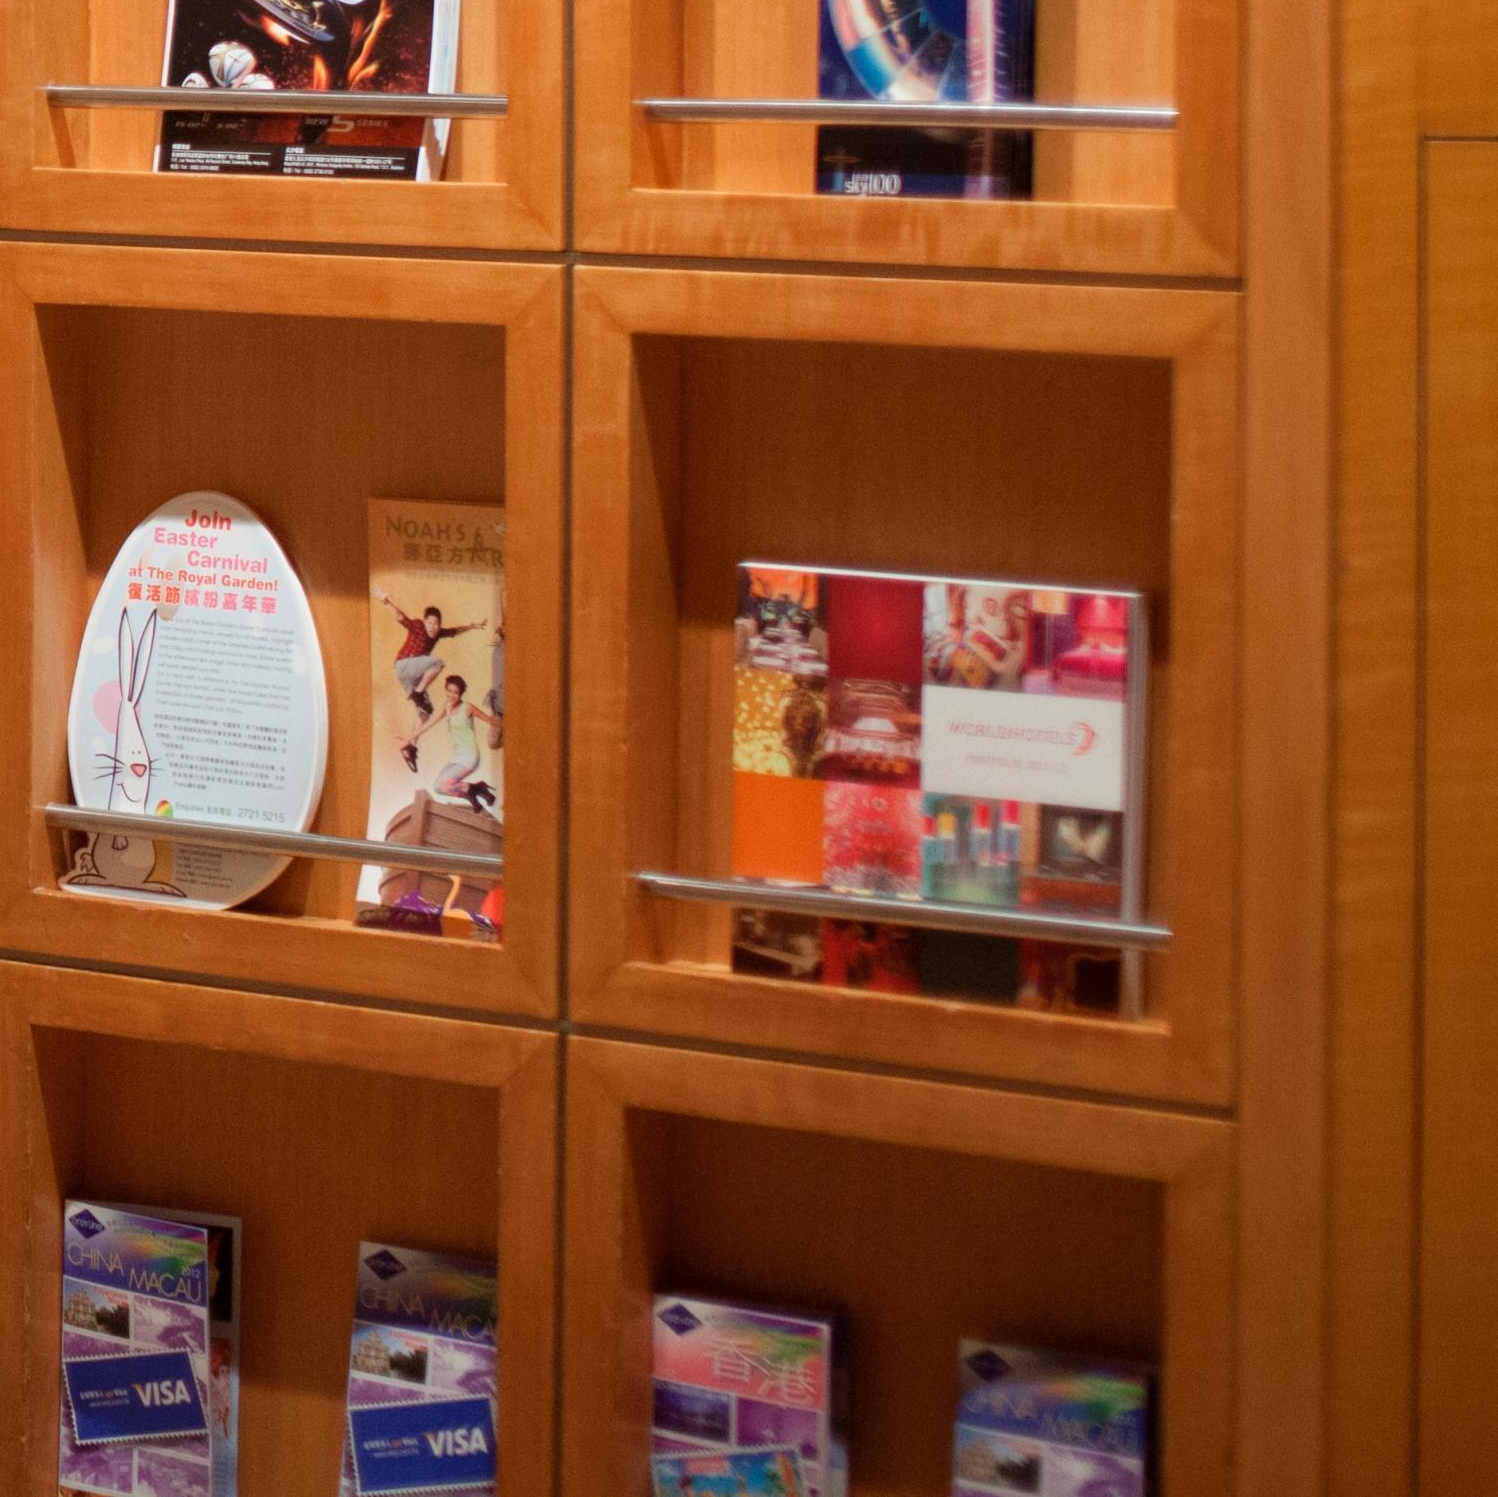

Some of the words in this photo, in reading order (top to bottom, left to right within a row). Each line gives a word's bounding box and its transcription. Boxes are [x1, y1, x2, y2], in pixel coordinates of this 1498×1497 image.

[185, 509, 232, 530] Join
[154, 527, 218, 548] Easter
[187, 550, 268, 574] Carnival
[128, 566, 143, 577] at
[148, 566, 173, 580] The
[178, 570, 216, 587] Royal
[221, 574, 278, 591] Garden!
[237, 807, 259, 819] 2721
[262, 810, 285, 822] 5215
[68, 1242, 124, 1277] CHINA
[129, 1267, 202, 1303] MACAU
[363, 1288, 425, 1318] CHINA
[429, 1308, 495, 1340] MACA
[131, 1380, 191, 1407] VISA
[422, 1427, 488, 1457] VISA
